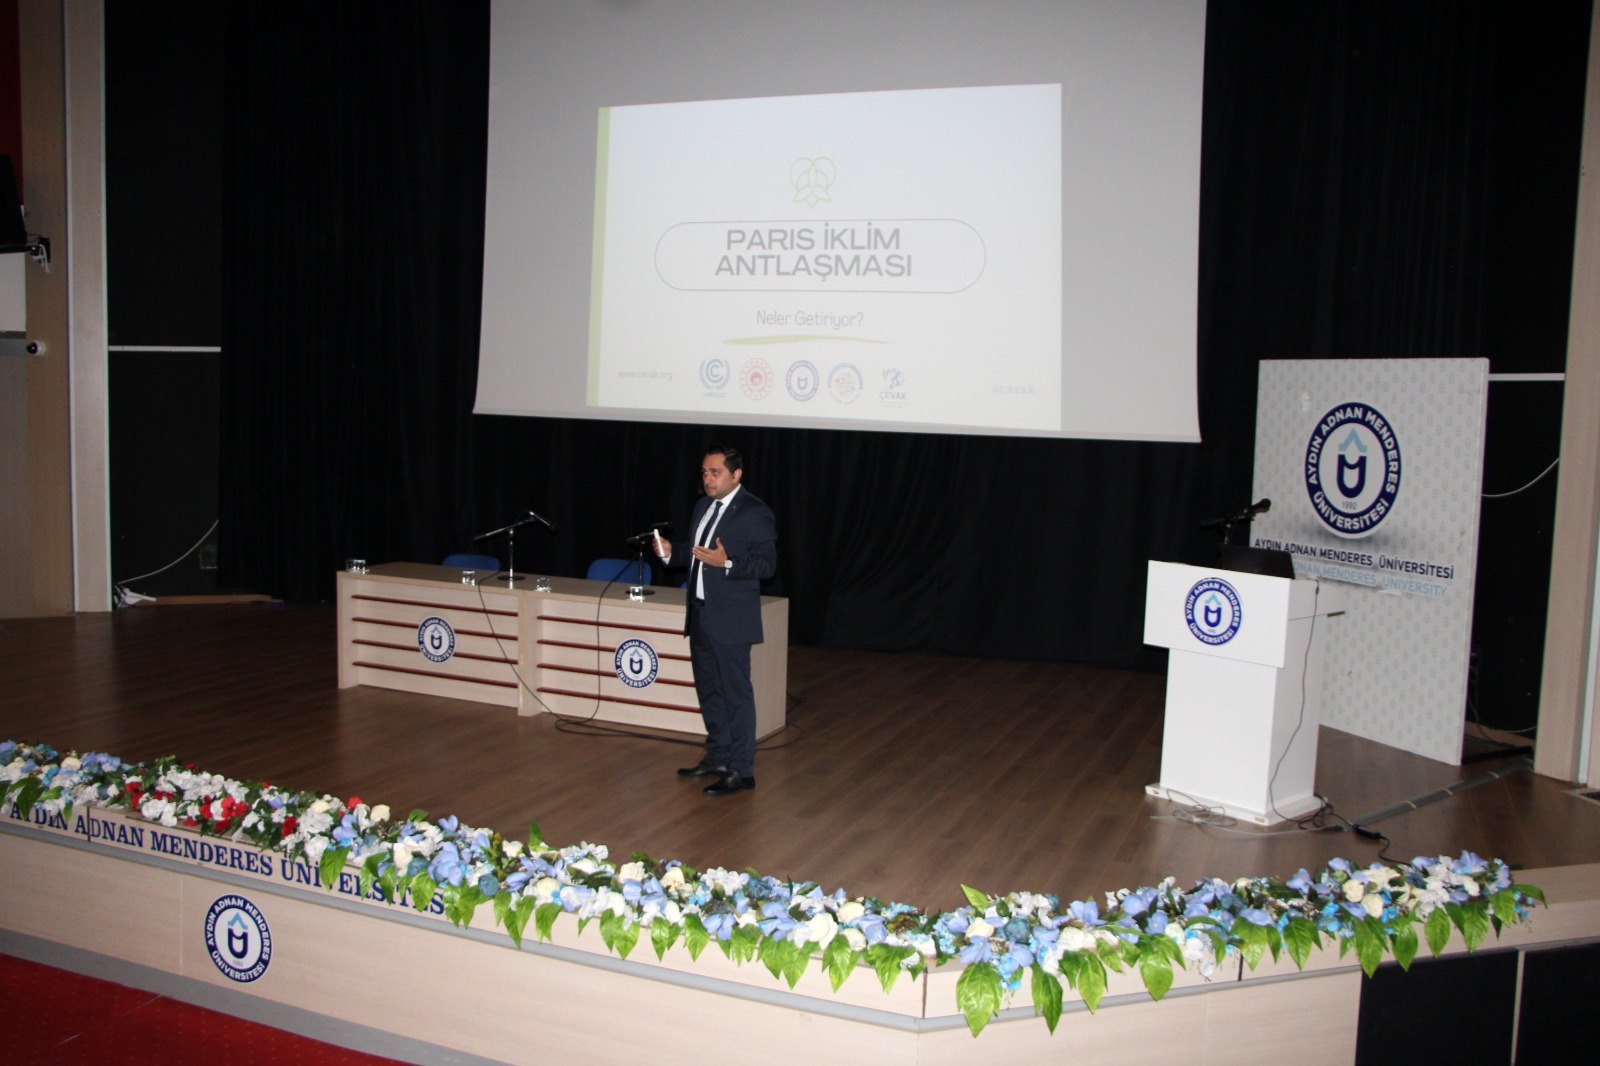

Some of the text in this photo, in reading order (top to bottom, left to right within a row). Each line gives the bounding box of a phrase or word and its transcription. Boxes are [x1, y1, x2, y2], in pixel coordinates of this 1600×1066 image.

[726, 222, 900, 250] PARIS İKLİM
[715, 254, 912, 281] ANTLAŞMASI
[757, 310, 864, 330] Neler Getiriyor?
[1308, 407, 1400, 494] AYDIN ADNAN MENDERES
[1254, 538, 1454, 579] AYDIN ADNAN MENDERES ÜNİVERSİTESİ
[1322, 564, 1377, 586] MENDERES
[1383, 576, 1448, 597] UNIVERSITY
[75, 815, 144, 847] ADNAN
[150, 830, 273, 876] MENDERES
[206, 897, 271, 961] AYDIN ADNAN MENDERES
